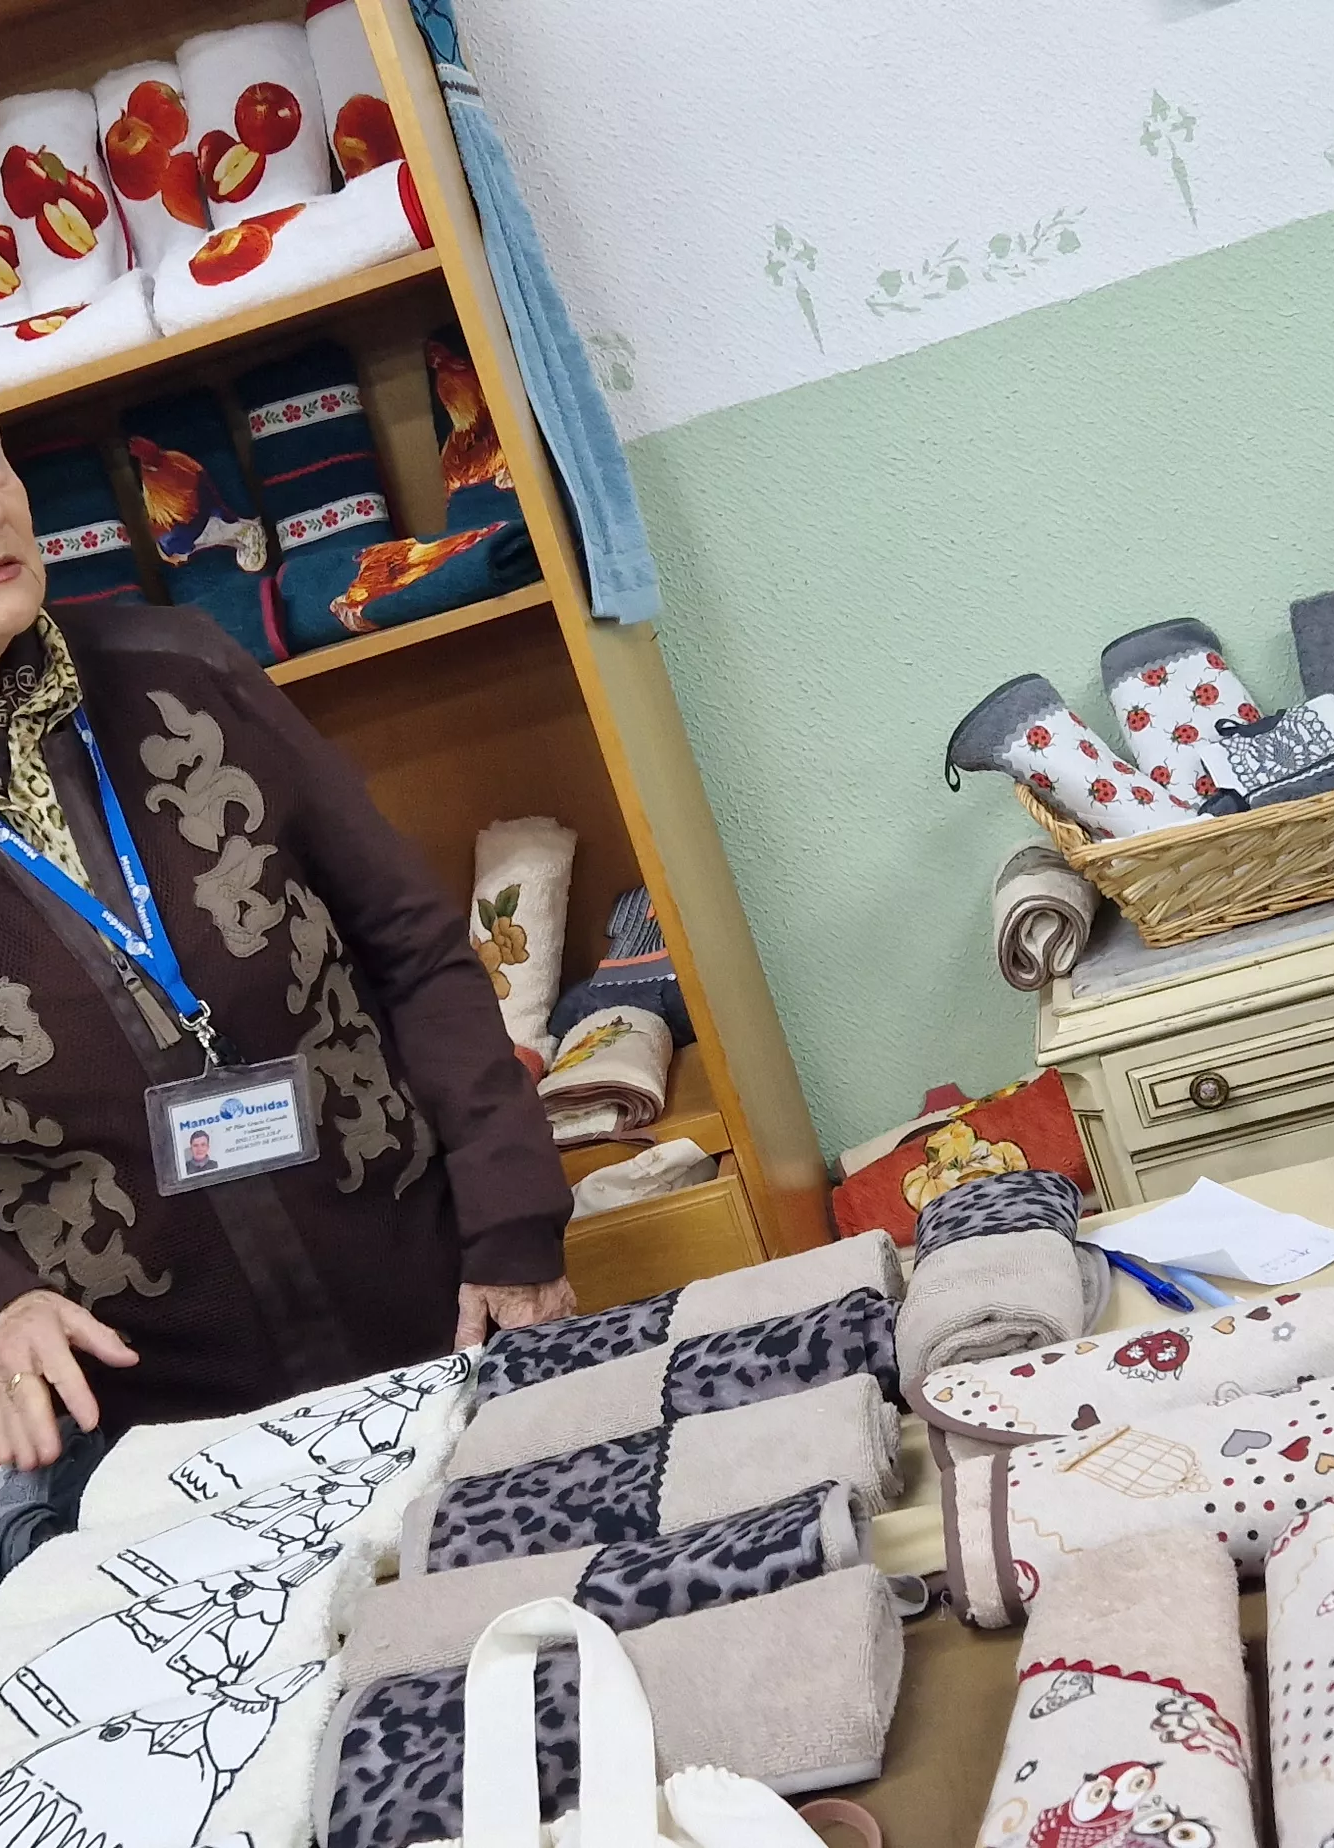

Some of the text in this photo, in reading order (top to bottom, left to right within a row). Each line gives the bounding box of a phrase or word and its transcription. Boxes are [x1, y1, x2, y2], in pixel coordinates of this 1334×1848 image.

[8, 833, 39, 860] Manos
[120, 854, 137, 889] Manos
[136, 904, 154, 940] Unidas
[179, 1099, 289, 1131] Manos Unidas
